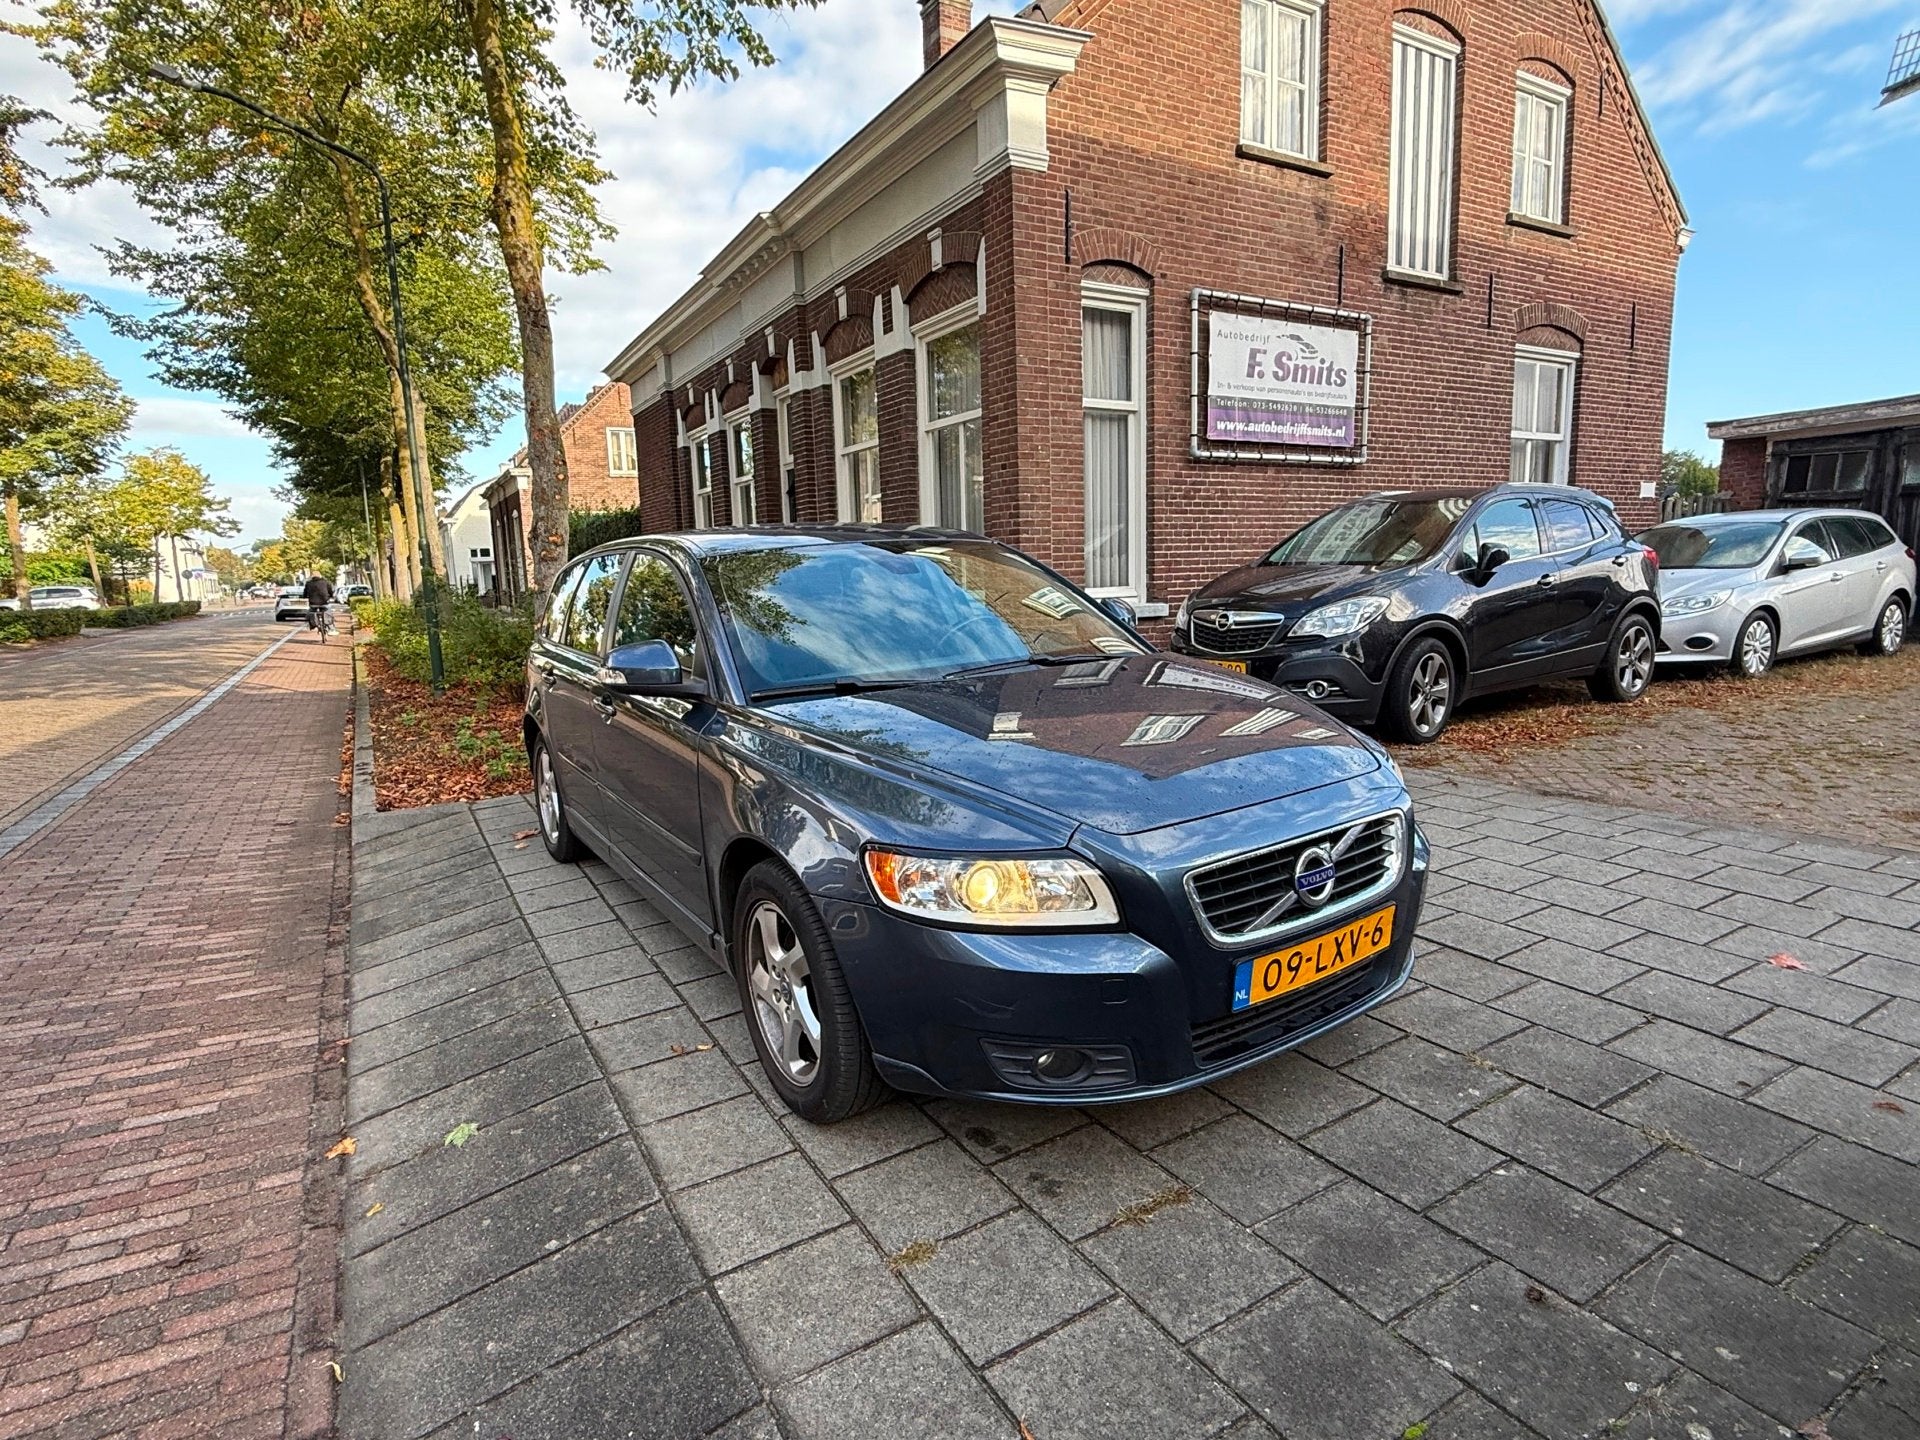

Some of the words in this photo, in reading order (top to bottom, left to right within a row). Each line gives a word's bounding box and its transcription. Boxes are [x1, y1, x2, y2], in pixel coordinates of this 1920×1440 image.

[1217, 329, 1271, 345] Autobedrijf
[1245, 347, 1267, 379] F.
[1272, 350, 1347, 387] Smits
[1233, 383, 1256, 392] verkoop
[1217, 398, 1250, 408] Telefoon:
[1216, 420, 1346, 438] www.autobedrijffsmits.nl
[1300, 869, 1333, 886] VOLVO
[1262, 916, 1384, 992] 09-LXV-6
[1235, 988, 1249, 1002] NL
